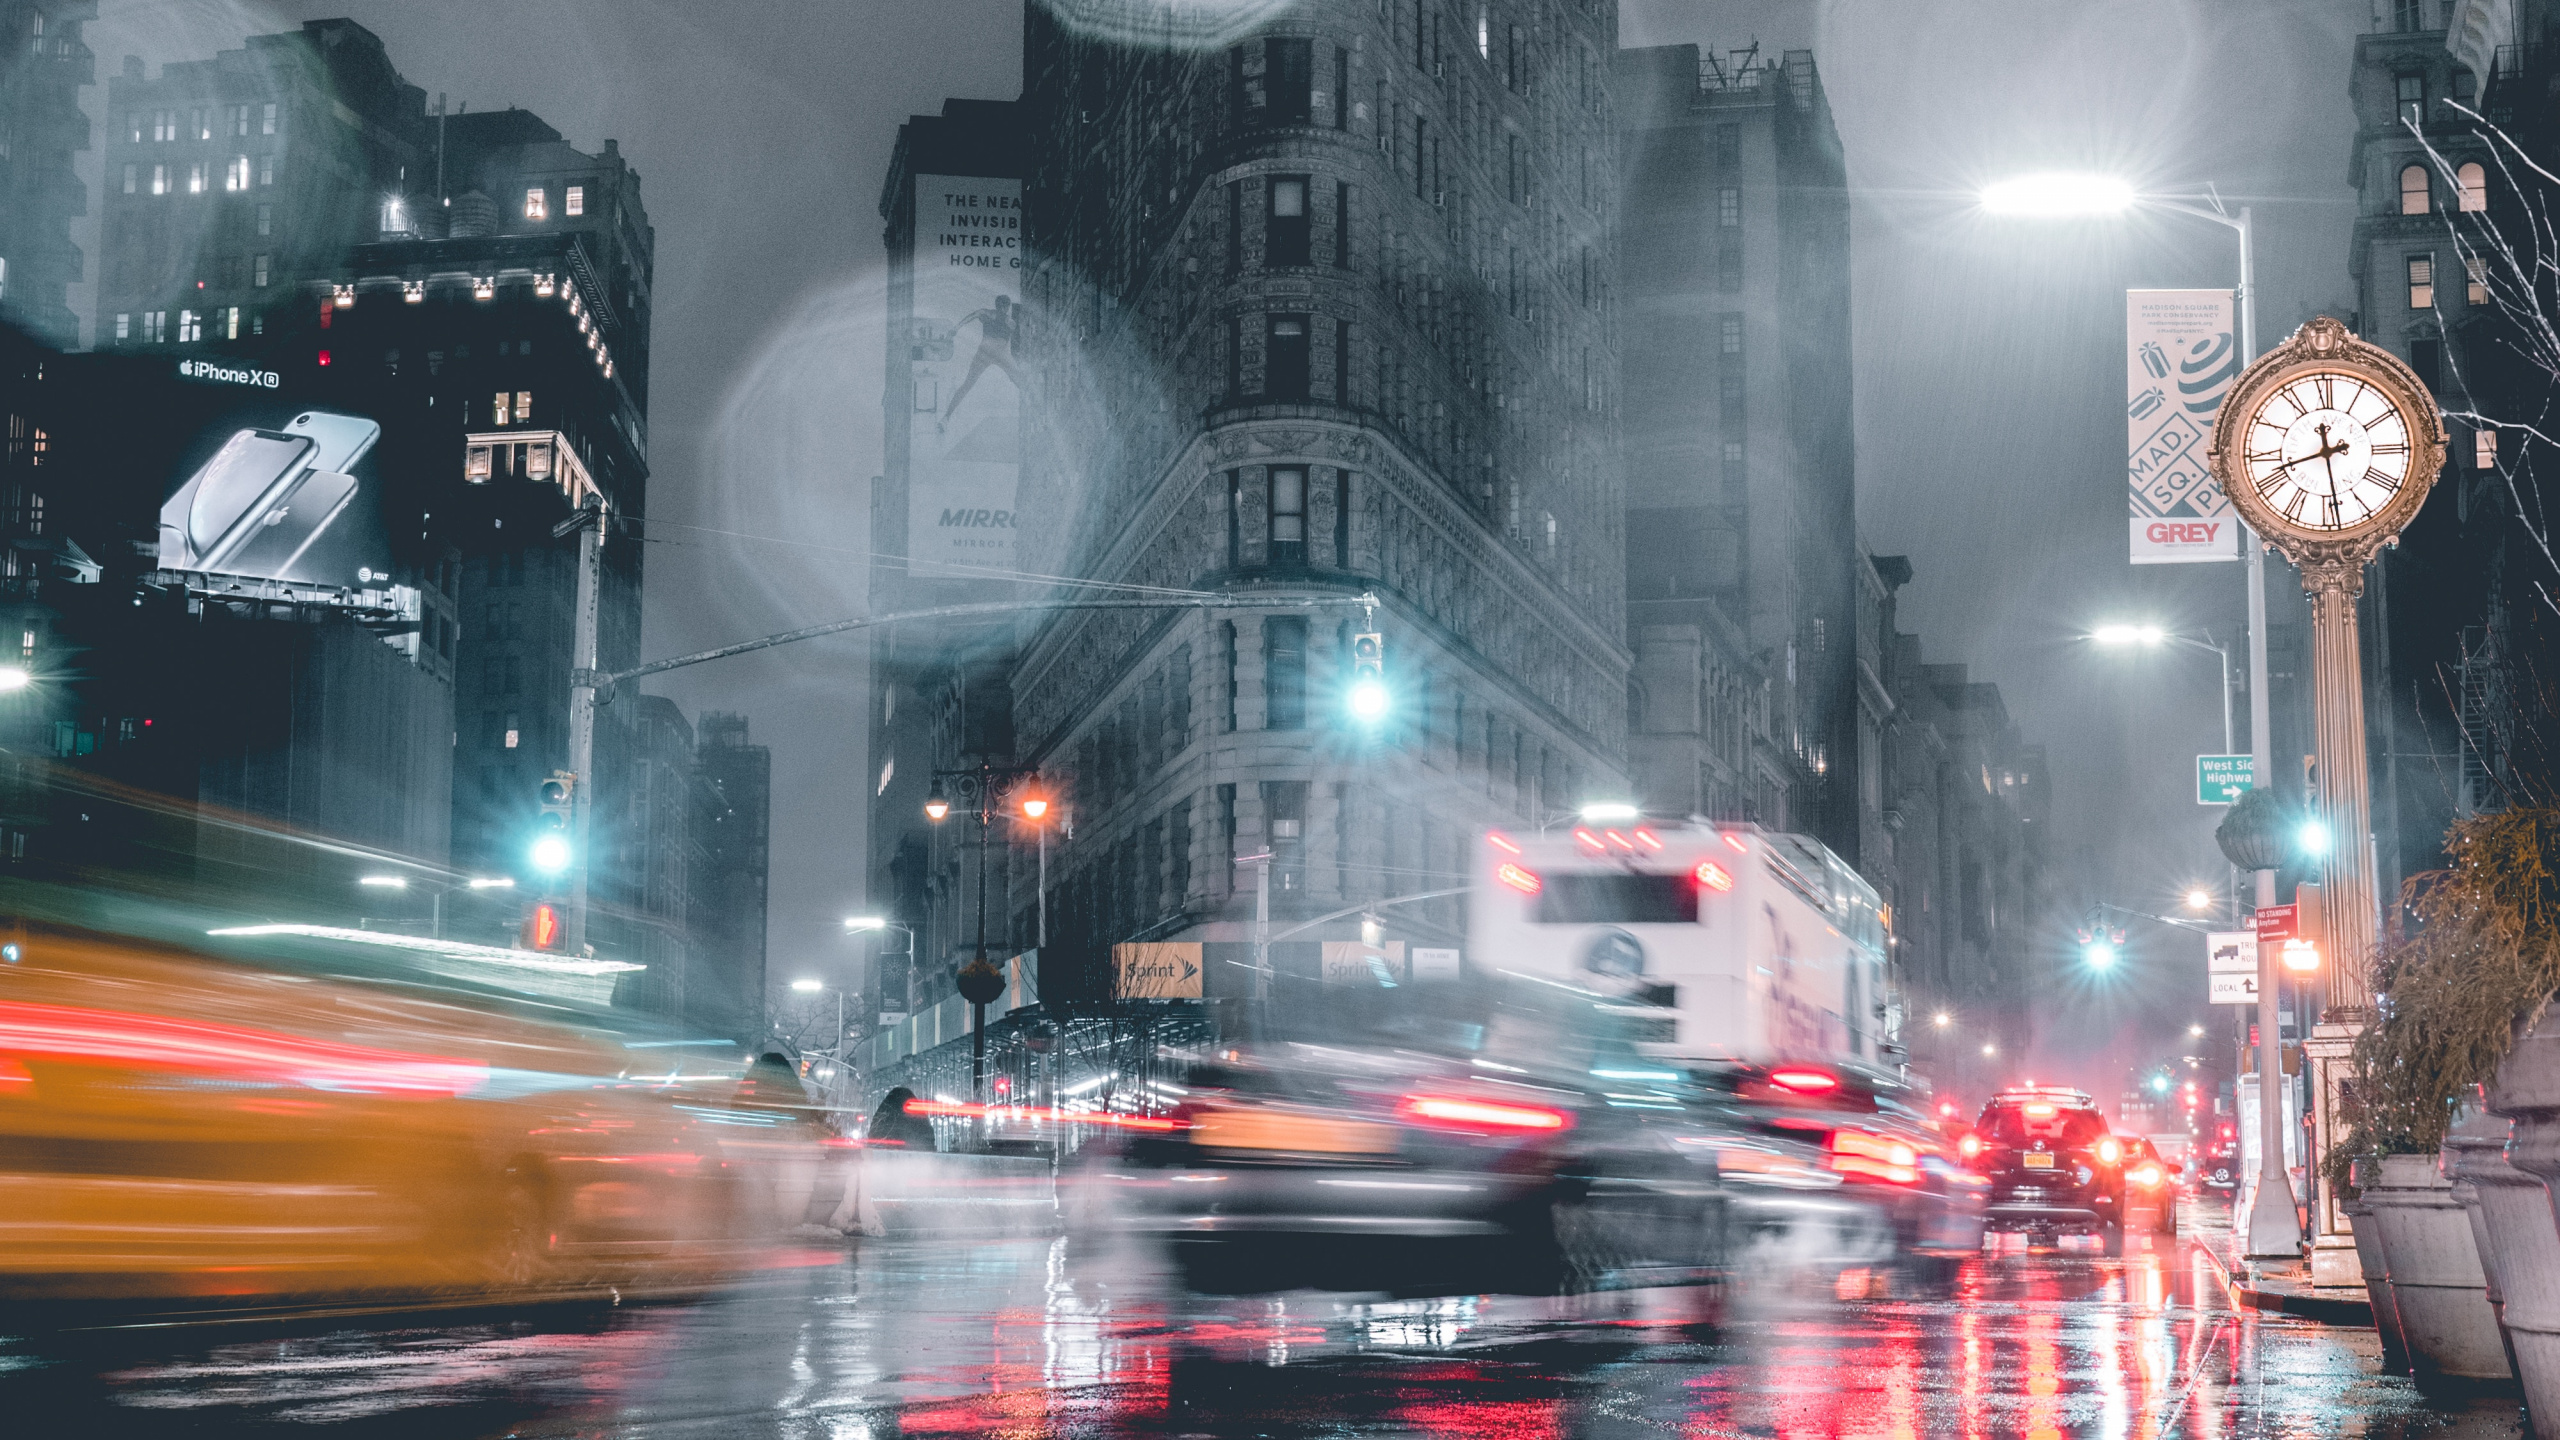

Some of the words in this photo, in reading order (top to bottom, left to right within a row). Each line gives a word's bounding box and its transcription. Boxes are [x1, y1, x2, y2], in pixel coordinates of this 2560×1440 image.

[945, 194, 978, 207] THE
[987, 195, 1021, 209] NEA
[951, 215, 1018, 229] INVISIB
[951, 254, 1001, 268] HOME
[194, 361, 249, 383] iPhone
[2129, 431, 2190, 483] MAD.
[2153, 471, 2197, 505] SQ.
[2146, 522, 2220, 543] GREY
[372, 572, 389, 581] AT&T
[2202, 760, 2233, 771] West
[2206, 772, 2252, 785] Highwa
[2257, 911, 2266, 919] NO
[2266, 908, 2292, 919] STANDING
[2258, 919, 2280, 928] Anytime
[2240, 941, 2257, 950] TRU
[2241, 955, 2257, 963] ROU
[1126, 962, 1175, 983] Sprint
[1328, 962, 1374, 982] Sprin
[2213, 984, 2239, 993] LOCAL
